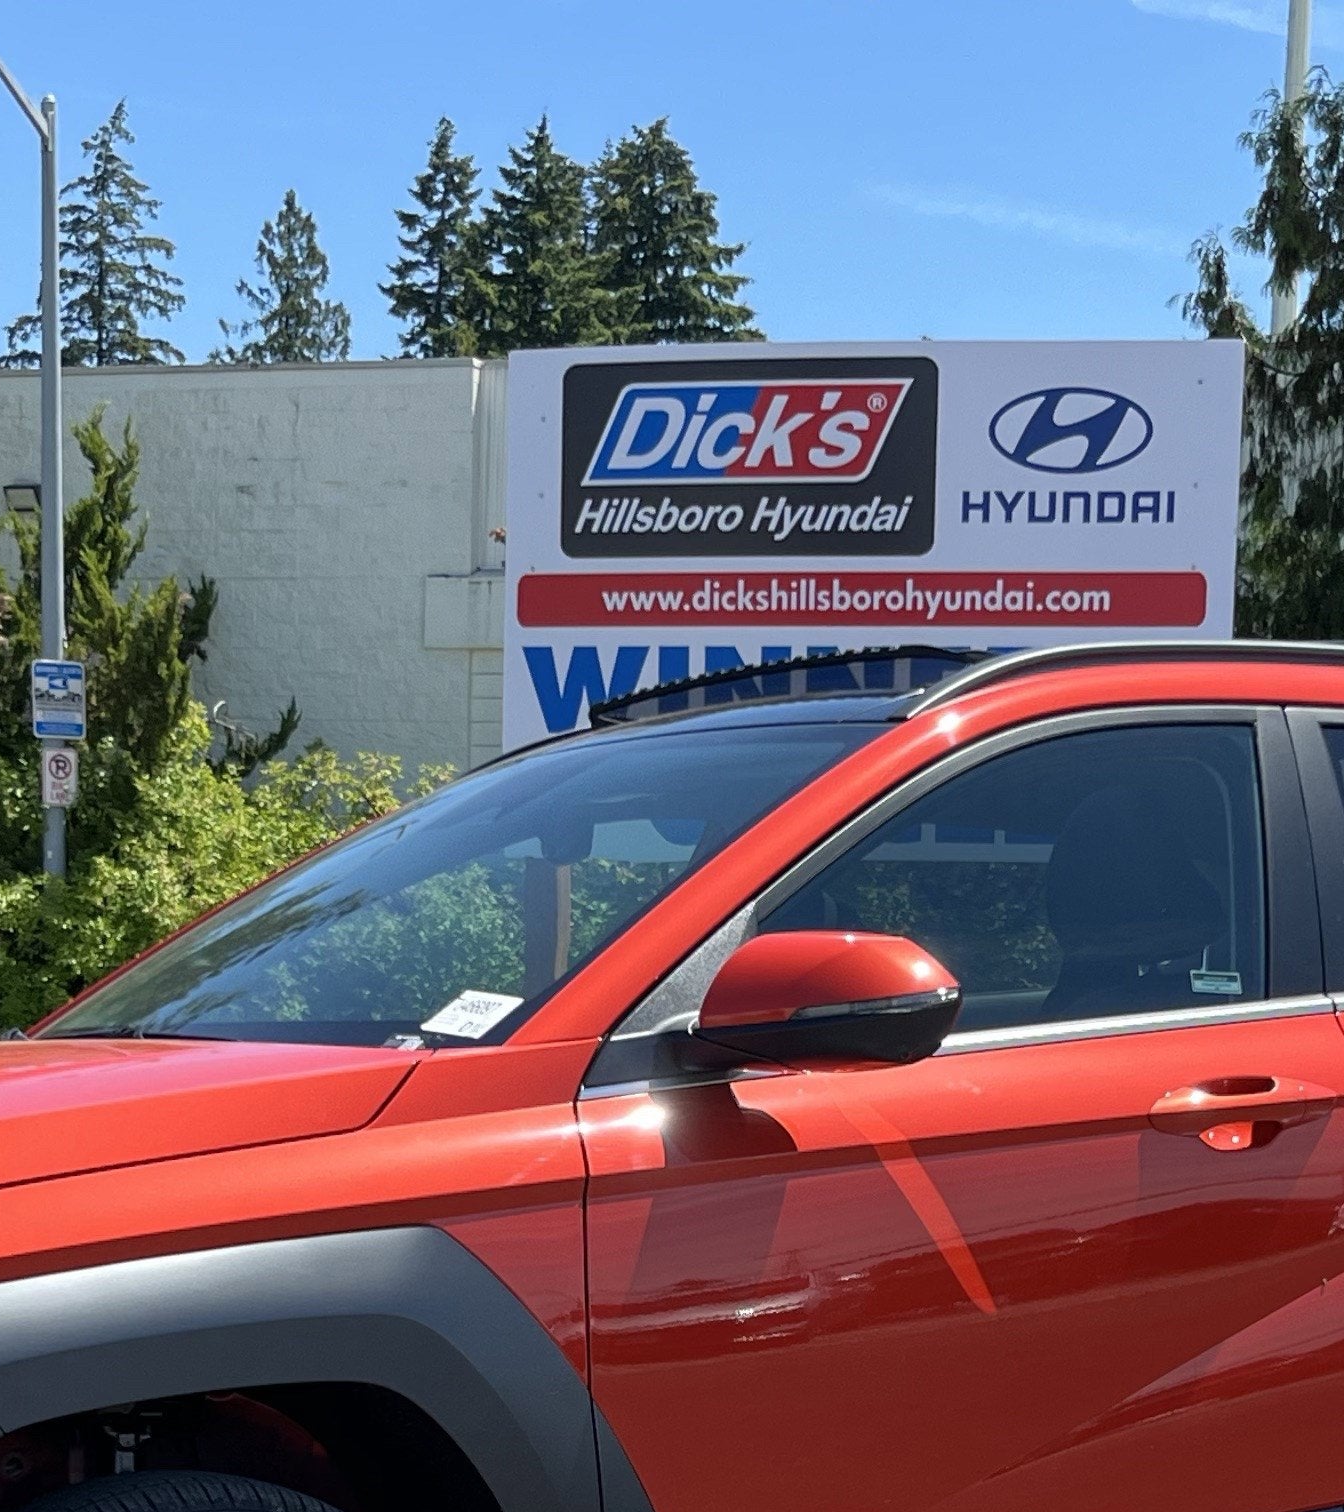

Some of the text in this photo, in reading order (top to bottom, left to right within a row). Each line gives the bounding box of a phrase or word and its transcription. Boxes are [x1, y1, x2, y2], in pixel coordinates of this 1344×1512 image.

[575, 496, 913, 541] Hillsboro Hyundai
[961, 491, 1175, 523] HYUNDAI
[602, 579, 1111, 619] www.dickshillsborohyundai.com
